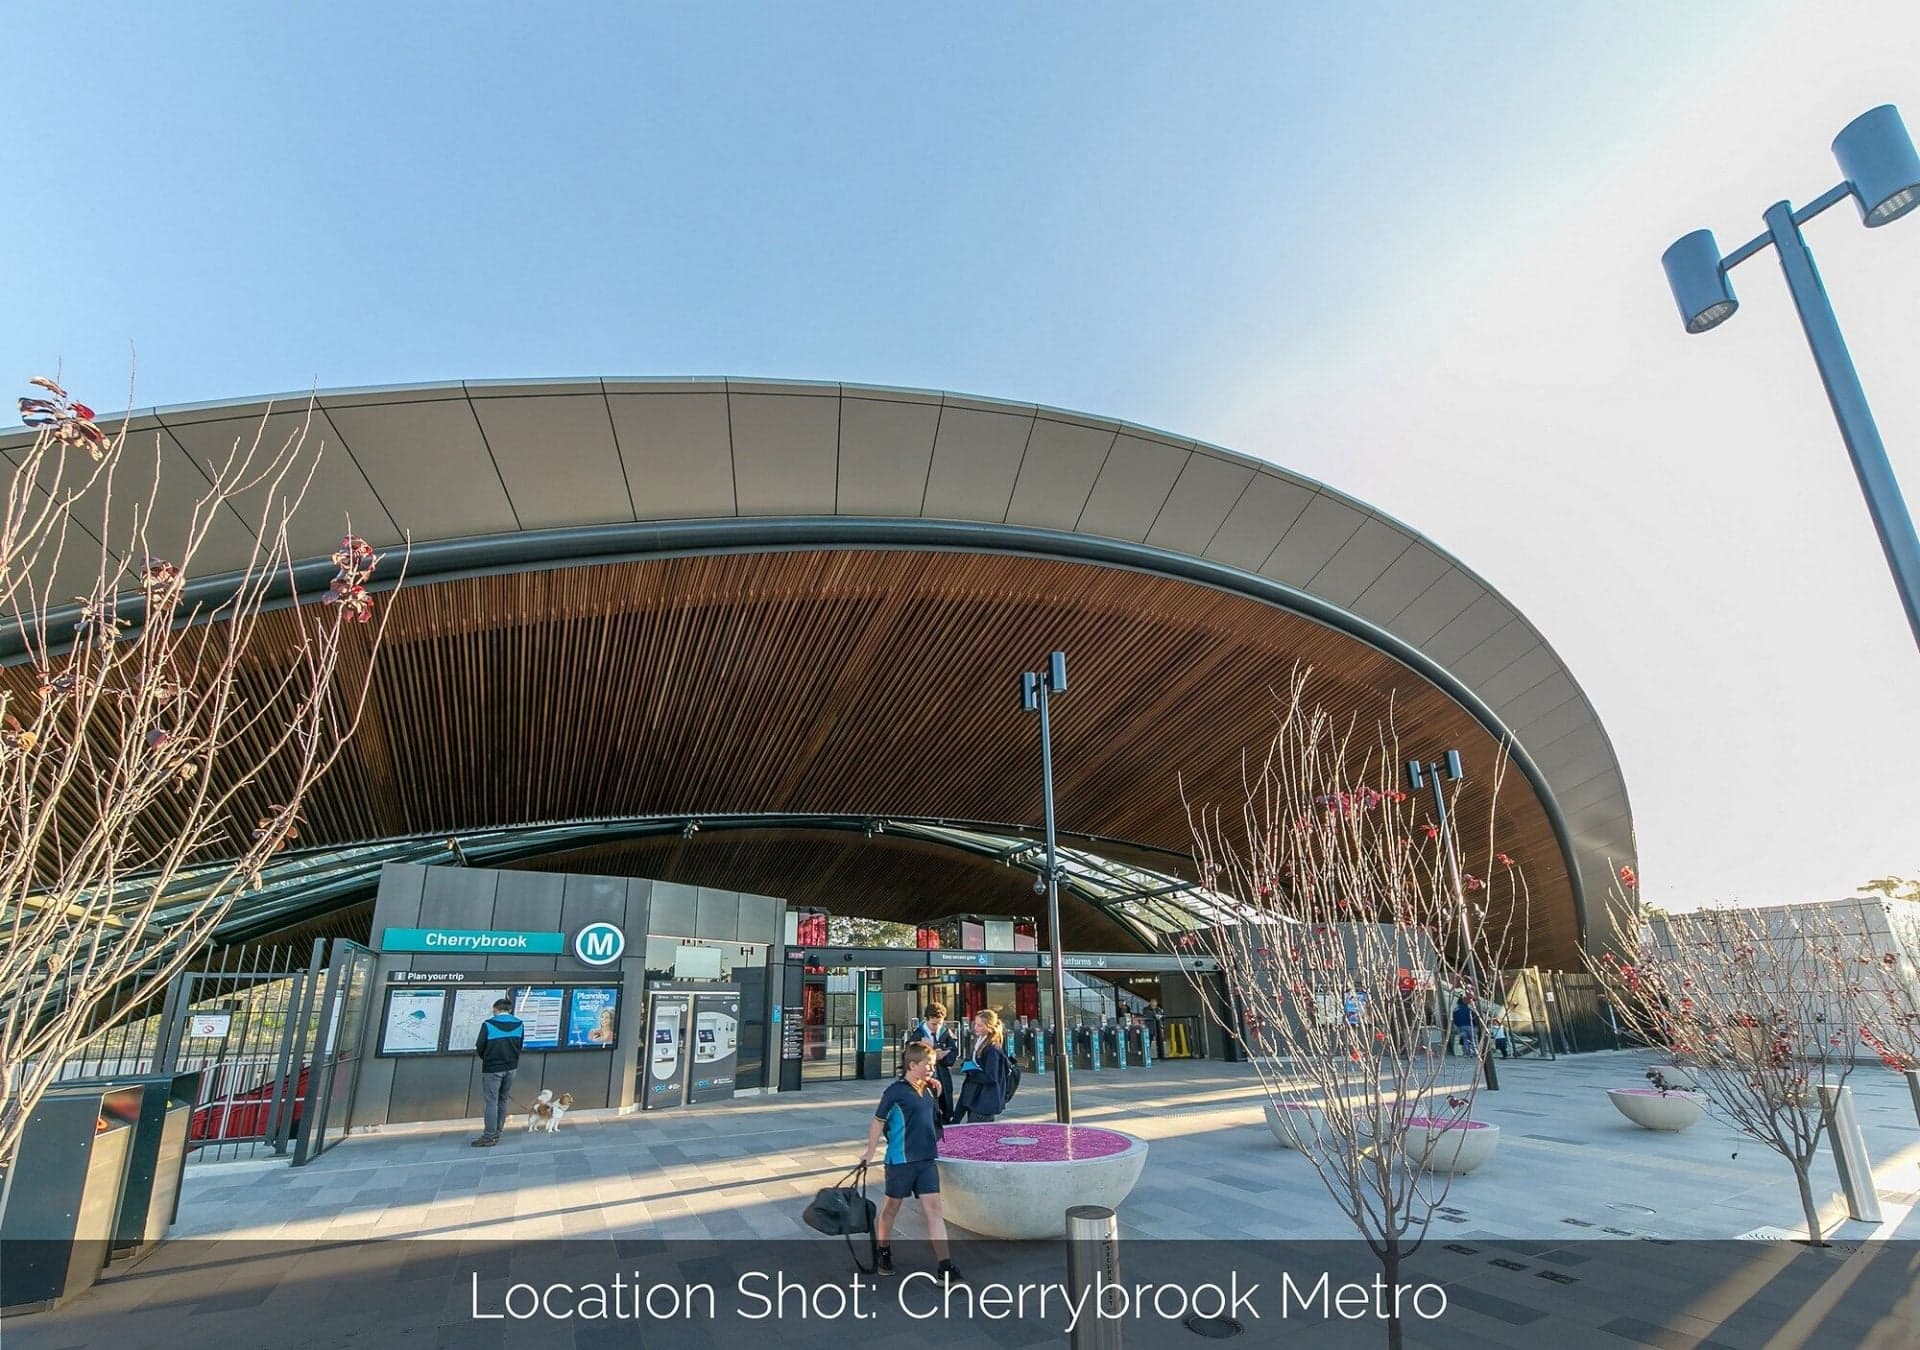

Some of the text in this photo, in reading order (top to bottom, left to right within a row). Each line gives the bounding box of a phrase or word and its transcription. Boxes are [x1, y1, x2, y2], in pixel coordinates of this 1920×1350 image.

[425, 932, 528, 949] Cherrybrook
[587, 932, 613, 956] M
[407, 972, 465, 982] Plan your trip
